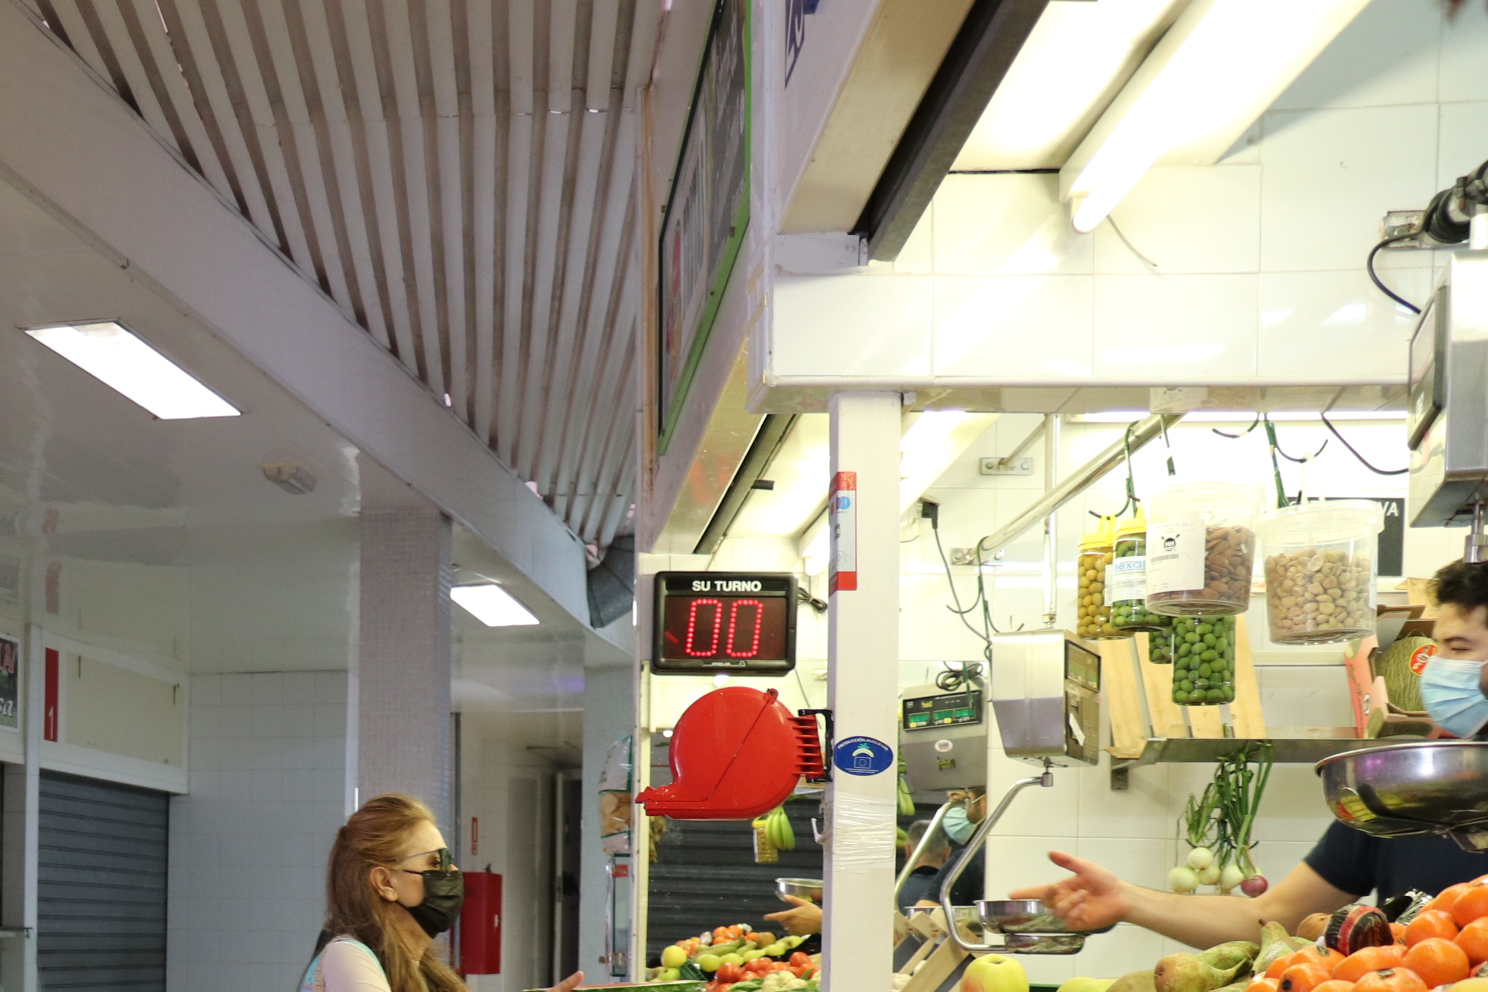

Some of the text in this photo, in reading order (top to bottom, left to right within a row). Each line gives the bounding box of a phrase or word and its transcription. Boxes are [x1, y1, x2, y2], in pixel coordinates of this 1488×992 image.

[692, 581, 762, 592] SU TURNO
[685, 599, 764, 657] 00
[48, 705, 54, 740] 1
